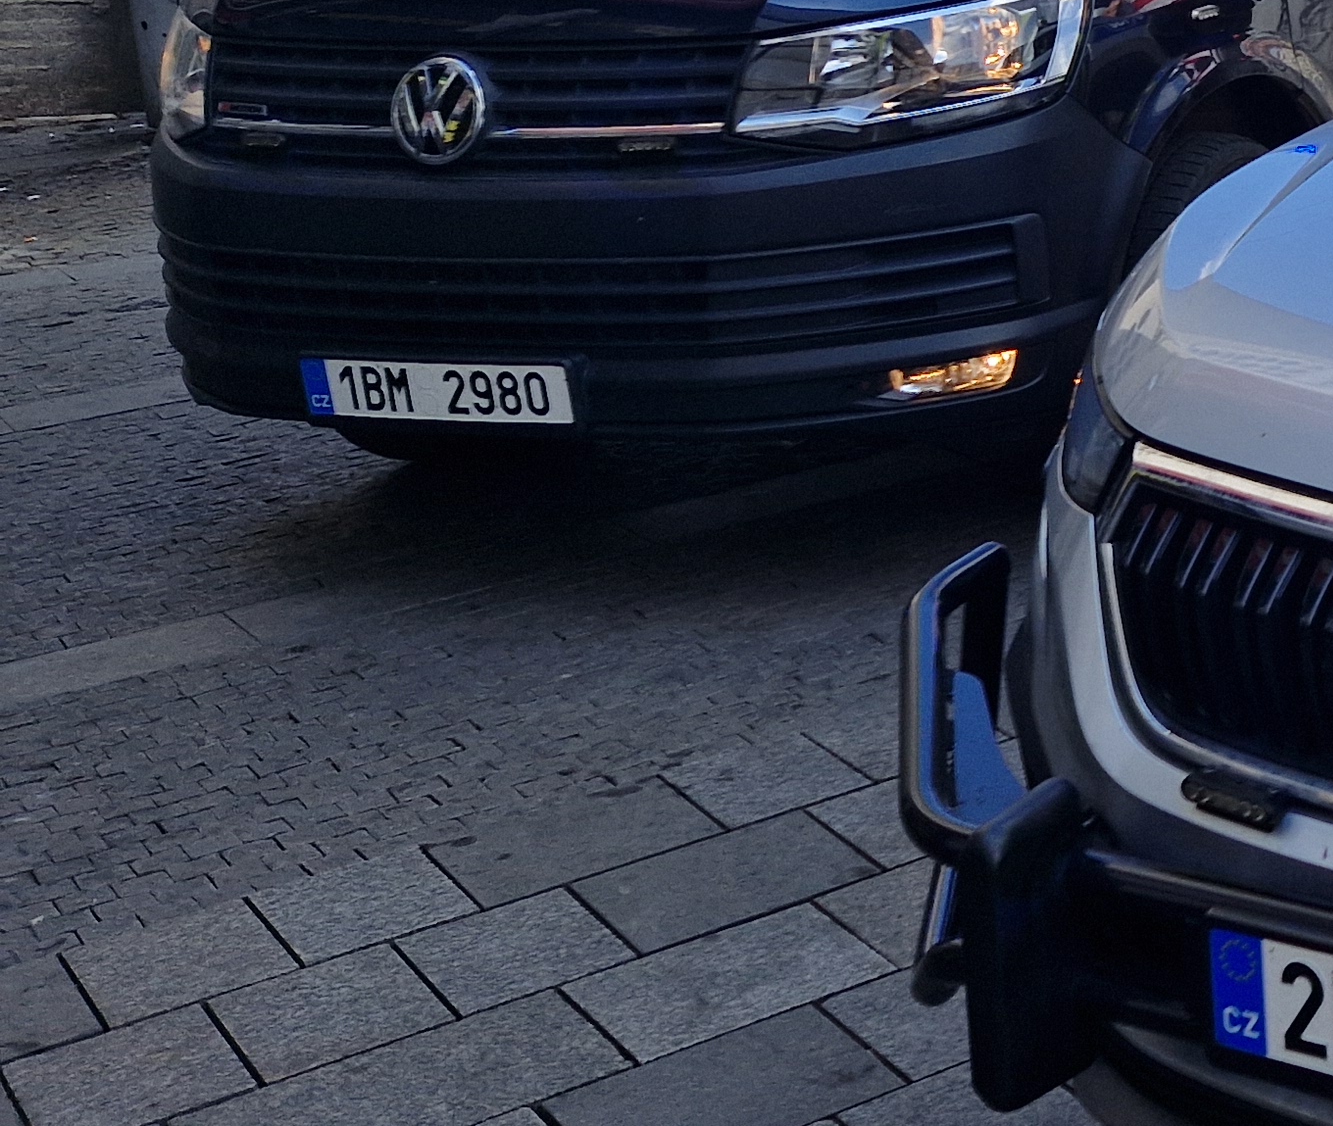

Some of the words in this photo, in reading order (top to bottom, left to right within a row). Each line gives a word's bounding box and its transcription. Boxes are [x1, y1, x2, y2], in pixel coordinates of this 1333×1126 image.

[311, 394, 331, 408] CZ
[339, 365, 415, 412] 1BM
[443, 369, 550, 416] 2980
[1222, 1005, 1262, 1040] CZ
